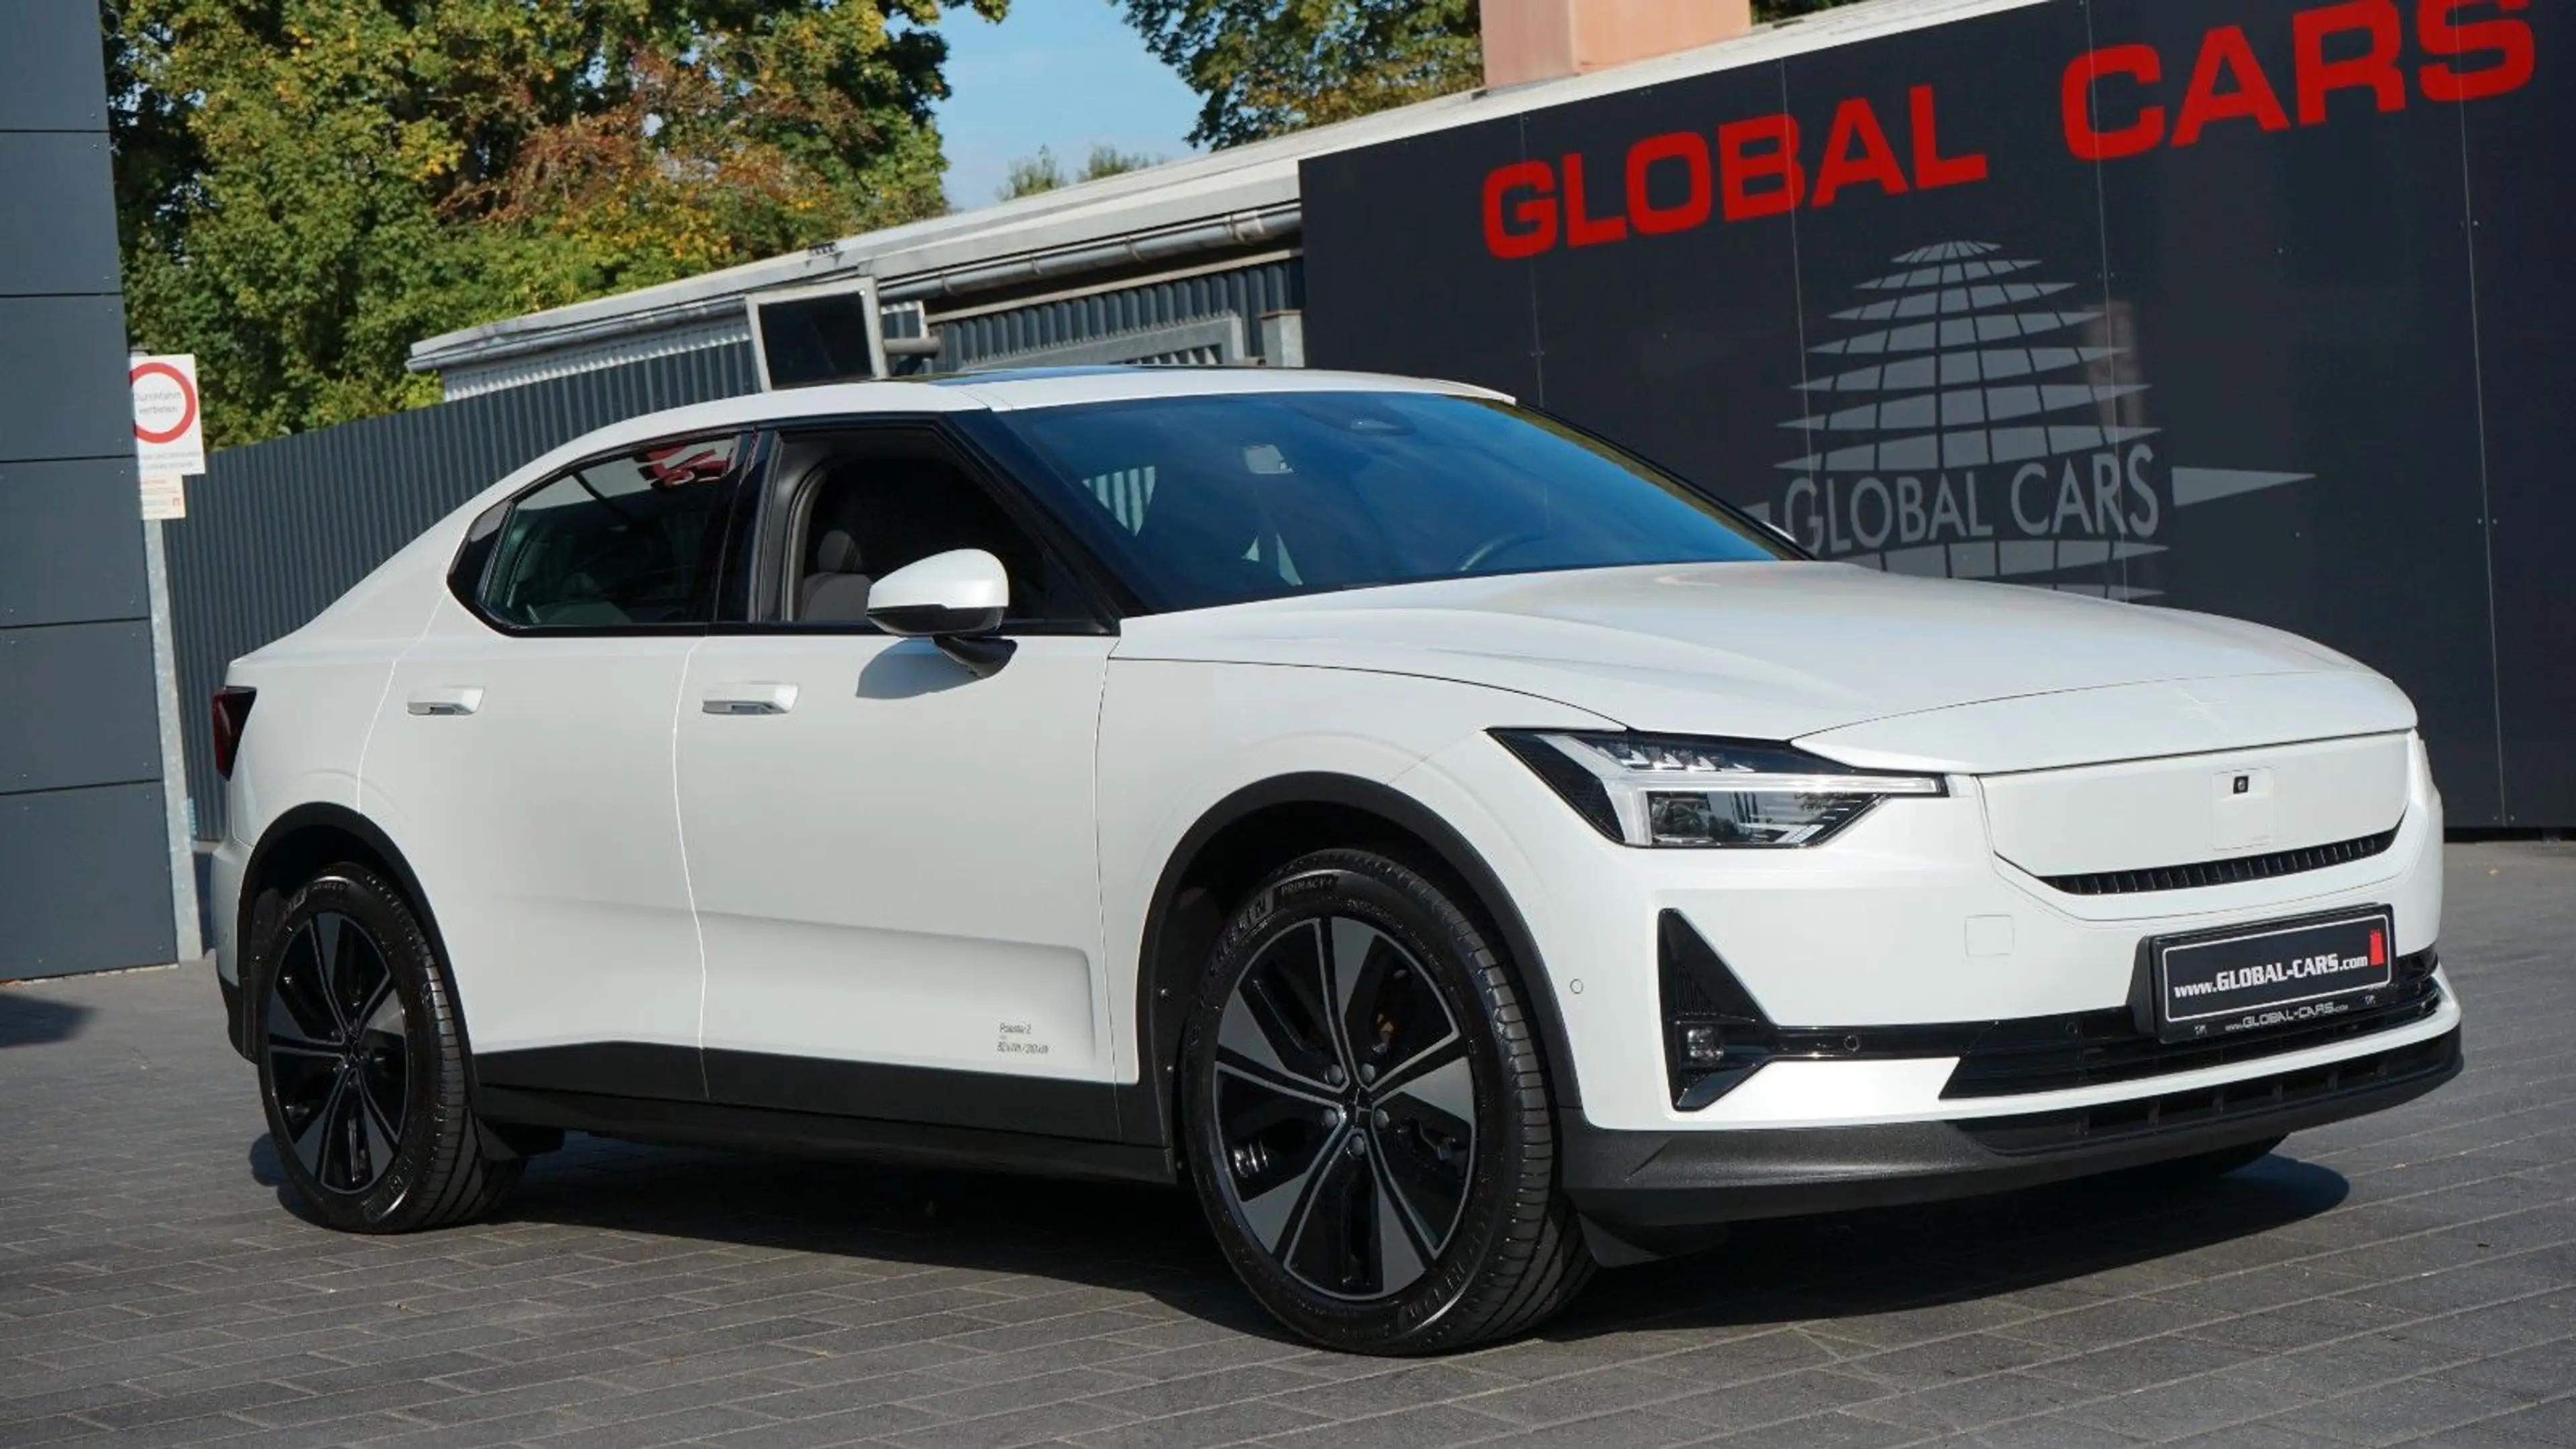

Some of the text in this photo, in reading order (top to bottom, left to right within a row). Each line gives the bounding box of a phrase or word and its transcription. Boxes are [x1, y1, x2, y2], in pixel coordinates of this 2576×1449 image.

[1483, 0, 2536, 260] GLOBAL CARS
[1784, 443, 2159, 558] GLOBAL CARS
[2174, 953, 2369, 998] www.GLOBAL-CARS.com
